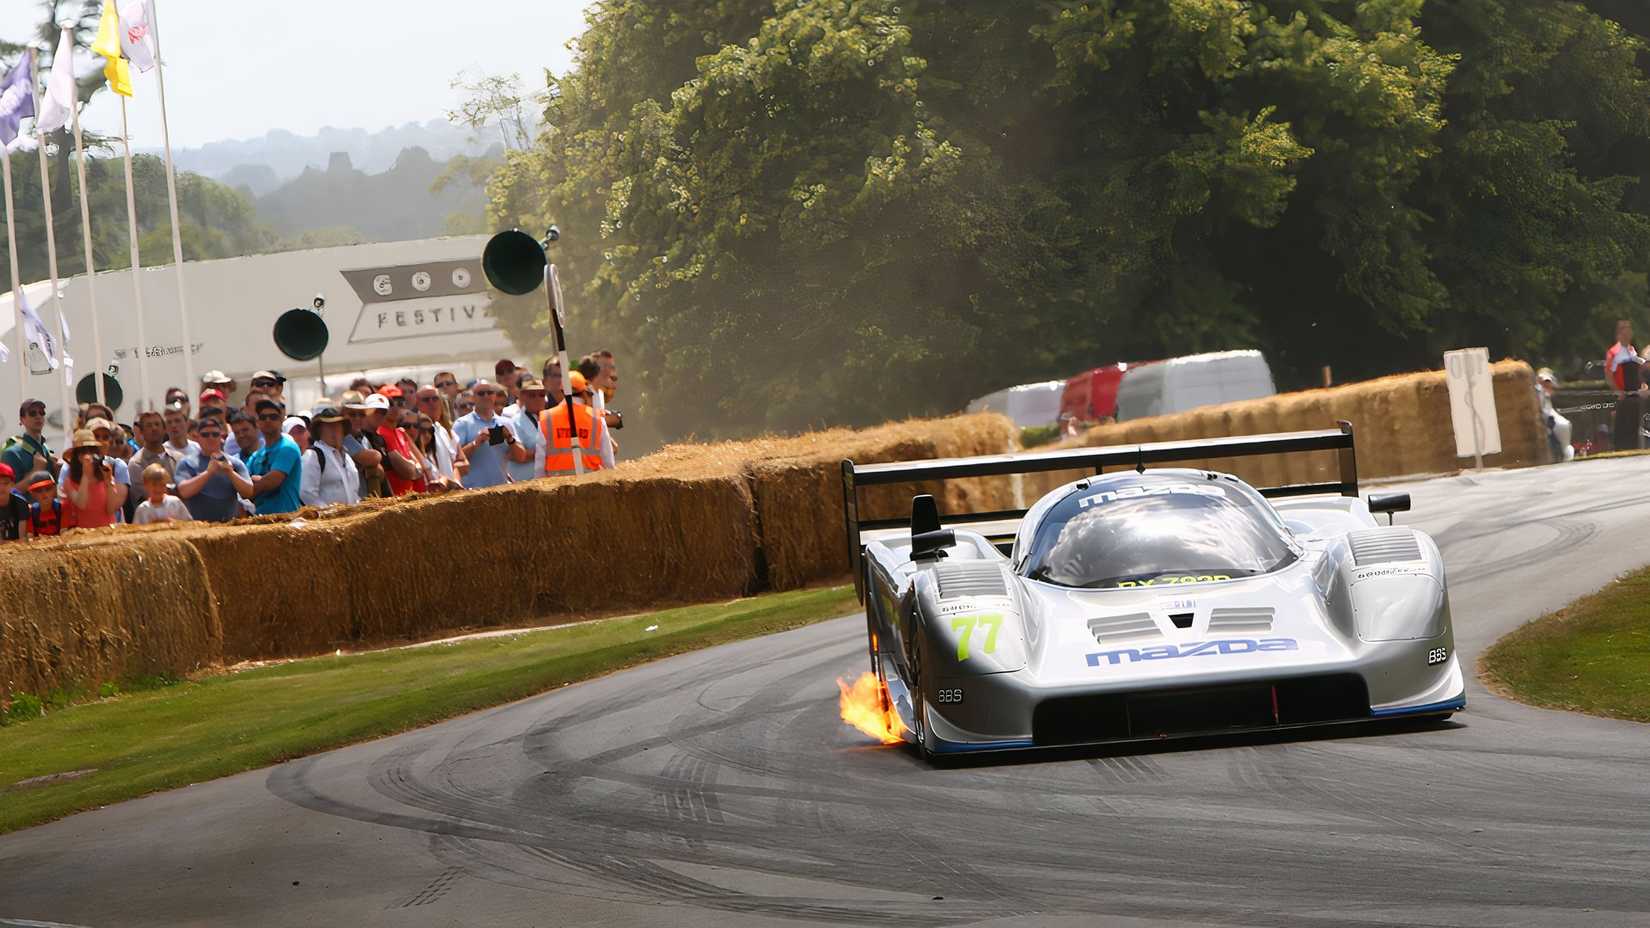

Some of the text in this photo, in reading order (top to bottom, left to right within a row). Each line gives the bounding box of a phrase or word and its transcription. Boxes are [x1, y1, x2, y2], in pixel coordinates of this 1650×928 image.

[377, 304, 490, 329] FESTIV
[950, 612, 1004, 662] 77
[1428, 648, 1447, 664] BBS
[938, 688, 963, 703] BBS
